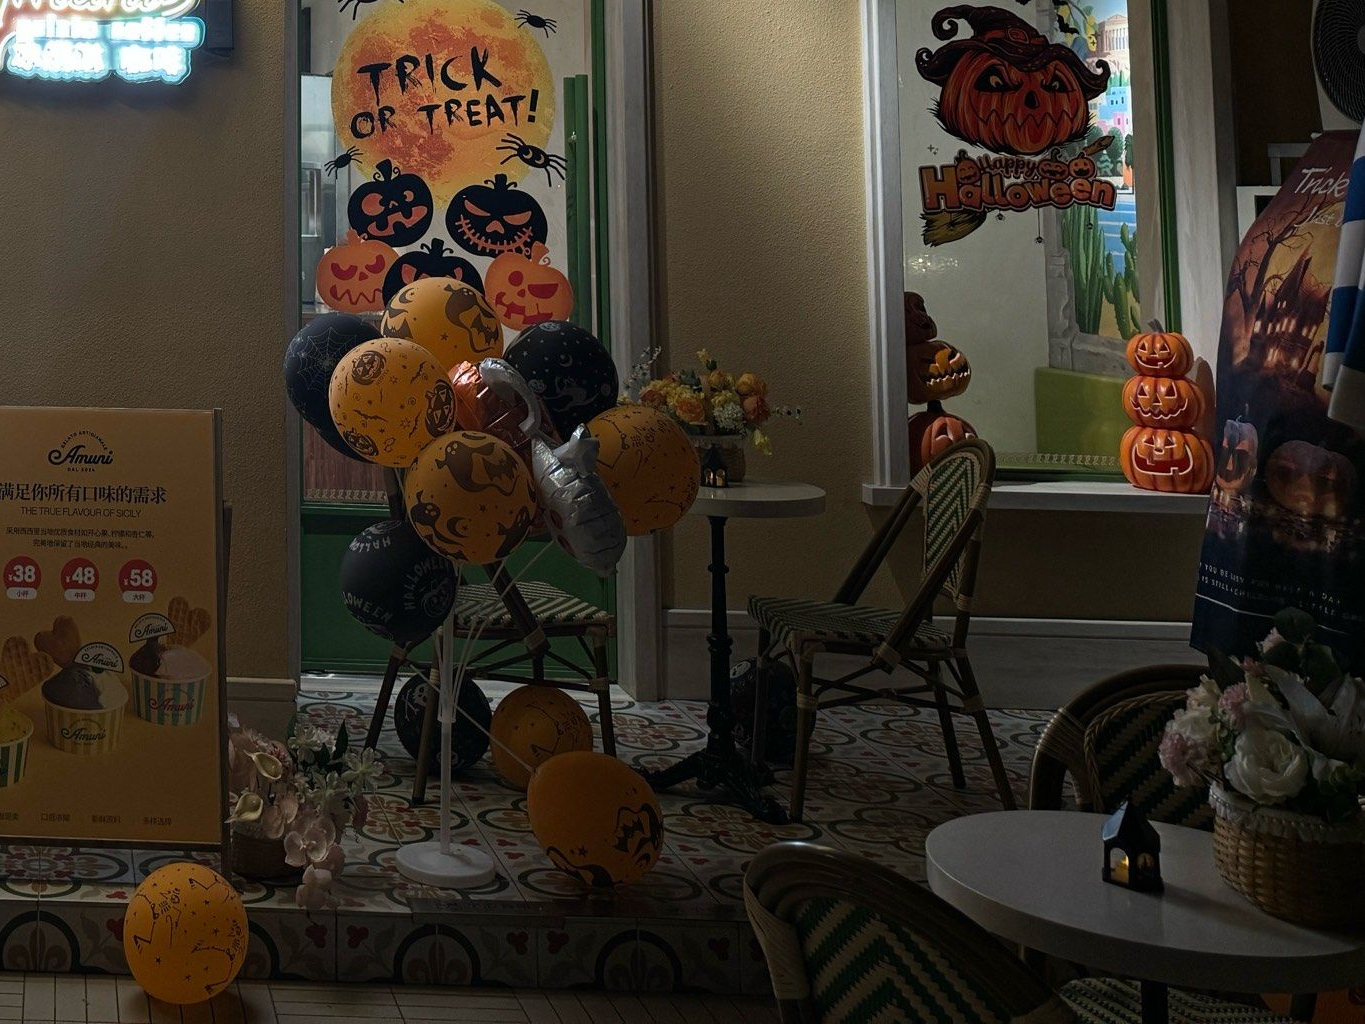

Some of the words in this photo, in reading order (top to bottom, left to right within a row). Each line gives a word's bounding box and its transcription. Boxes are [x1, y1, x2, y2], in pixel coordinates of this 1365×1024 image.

[357, 46, 502, 106] TRICK
[350, 105, 397, 139] OR
[417, 89, 539, 134] TREAT!
[976, 154, 1038, 180] Happy
[919, 164, 1118, 213] Halloween
[1294, 166, 1350, 197] Trick
[48, 444, 114, 466] Amuni
[20, 506, 37, 516] THE
[39, 506, 61, 516] TRUE
[62, 508, 102, 517] FLAVOUR
[103, 509, 114, 517] OF
[116, 509, 142, 518] SICILY
[8, 564, 36, 583] ¥38
[65, 566, 96, 585] ¥48
[123, 569, 154, 587] ¥58
[134, 623, 169, 638] Amuni
[81, 653, 119, 668] Amuni
[148, 697, 195, 712] Amuni
[60, 727, 107, 742] Amuni
